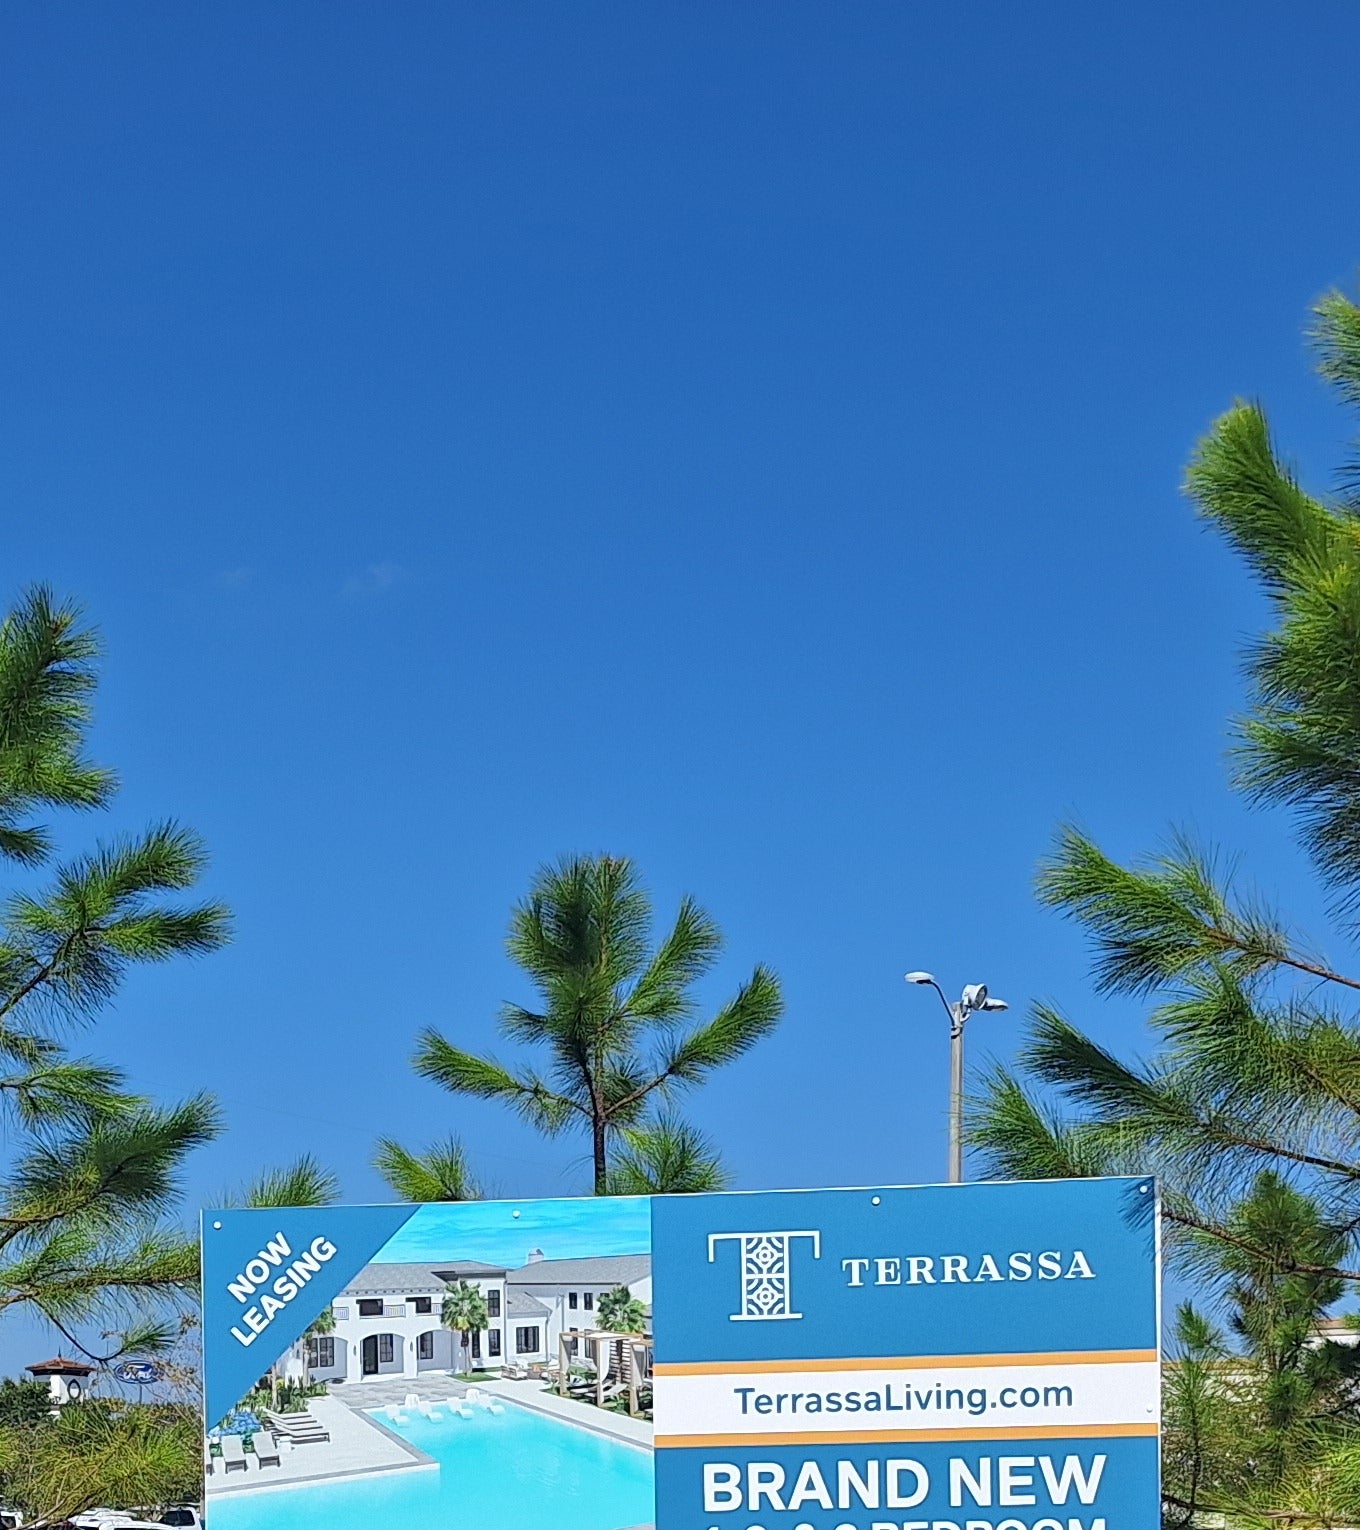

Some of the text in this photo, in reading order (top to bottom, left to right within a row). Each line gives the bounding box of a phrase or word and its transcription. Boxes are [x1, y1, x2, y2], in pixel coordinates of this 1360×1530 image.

[227, 1231, 292, 1303] NOW
[230, 1236, 337, 1347] LEASING
[842, 1250, 1096, 1287] TERRASSA
[733, 1382, 1073, 1416] TerrassaLiving.com
[703, 1454, 1107, 1512] BRAND NEW
